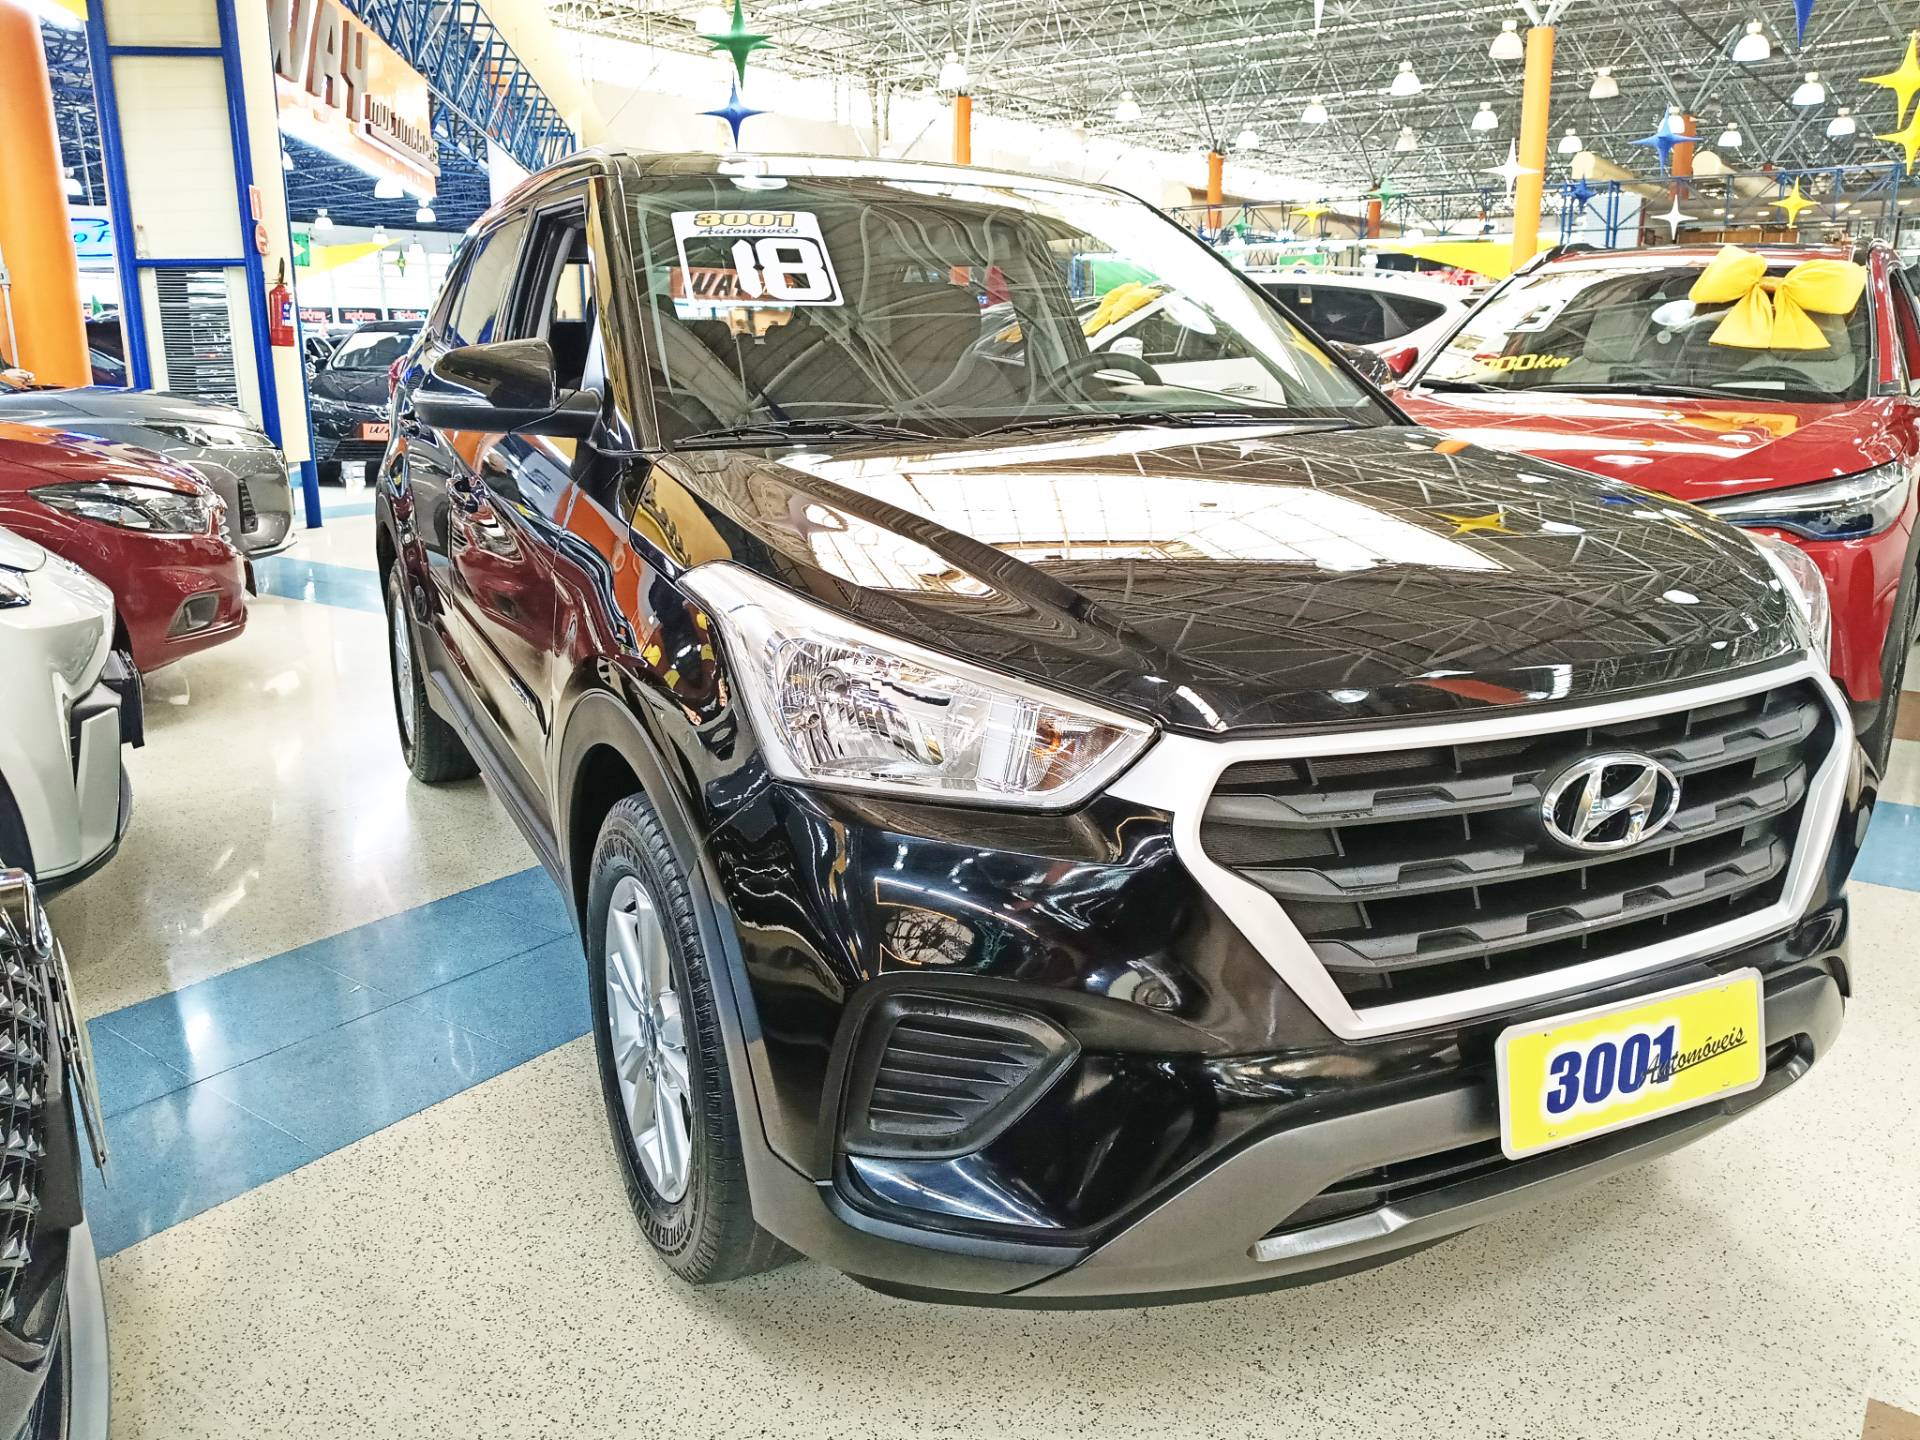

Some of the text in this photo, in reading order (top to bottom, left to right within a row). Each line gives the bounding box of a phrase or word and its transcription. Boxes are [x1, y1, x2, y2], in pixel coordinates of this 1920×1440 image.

[694, 213, 794, 227] 3001
[731, 238, 833, 301] 18
[1546, 1025, 1747, 1114] 3001 Automóveis
